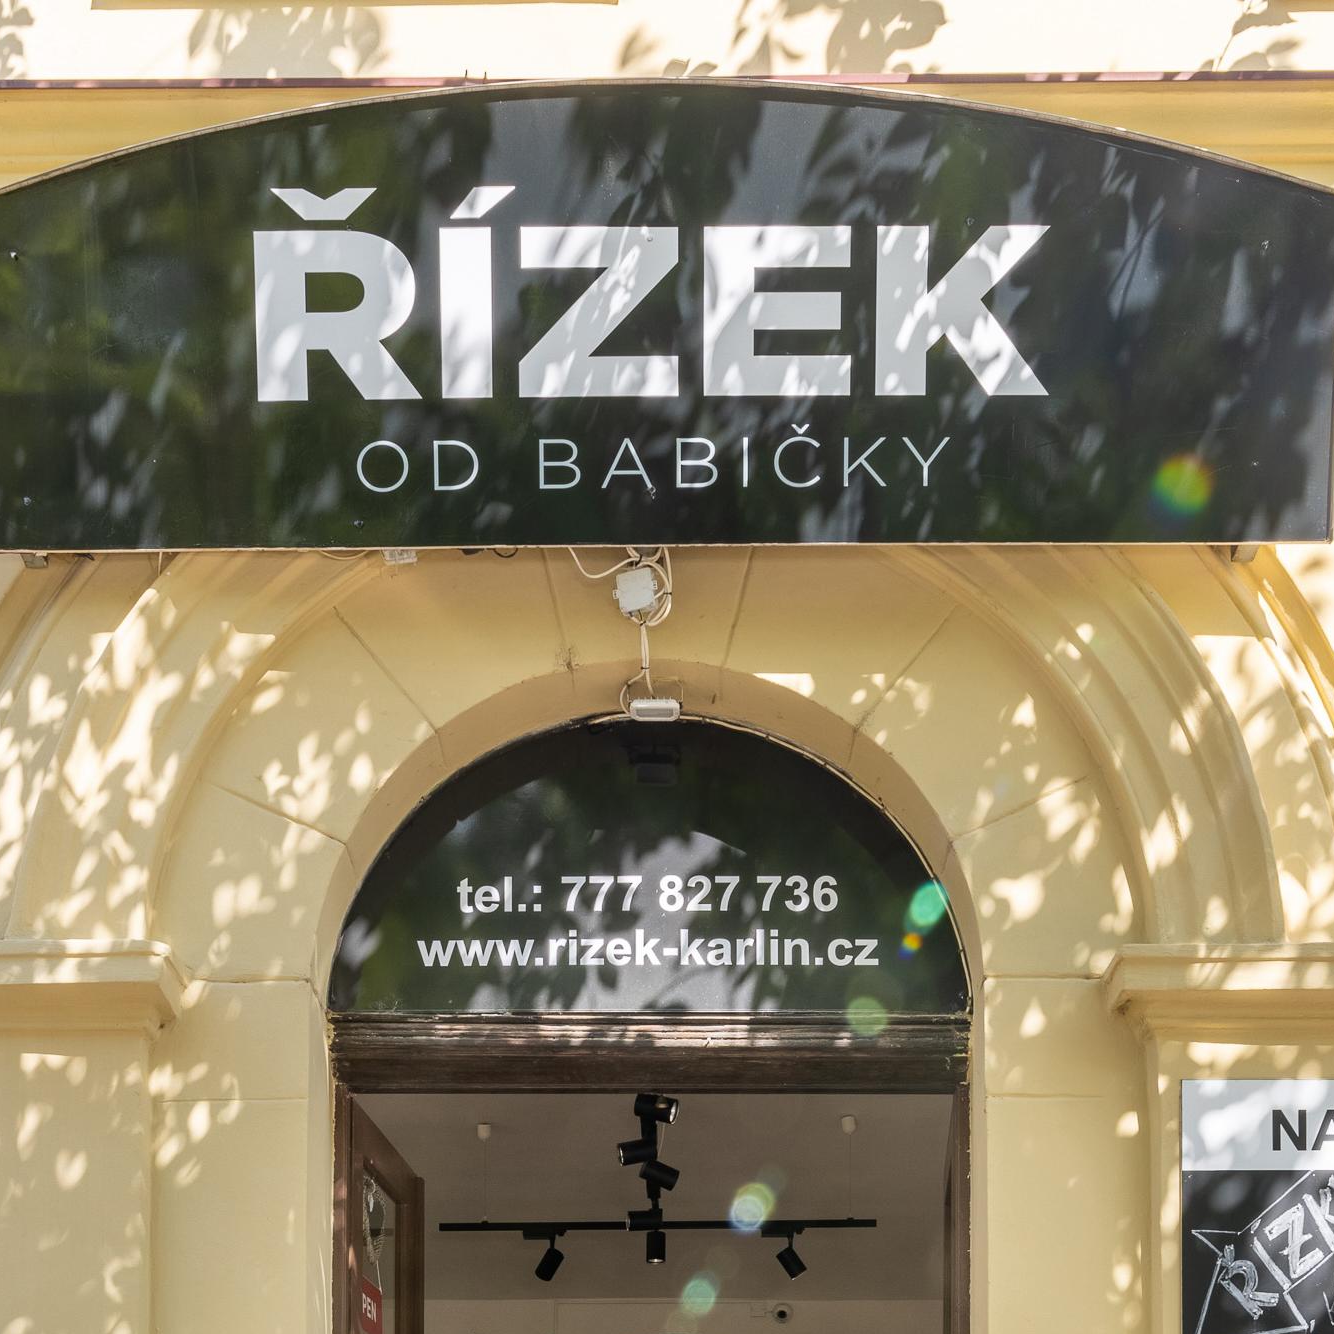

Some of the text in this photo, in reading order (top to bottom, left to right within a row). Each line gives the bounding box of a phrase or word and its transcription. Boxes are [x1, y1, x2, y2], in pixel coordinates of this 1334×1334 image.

[252, 186, 1052, 402] ŘÍZEK
[355, 422, 952, 494] OD BABIČKY
[457, 875, 839, 914] tel.: 777 827 736
[417, 928, 879, 967] www.rizek-karlin.cz
[362, 1292, 377, 1324] PEN
